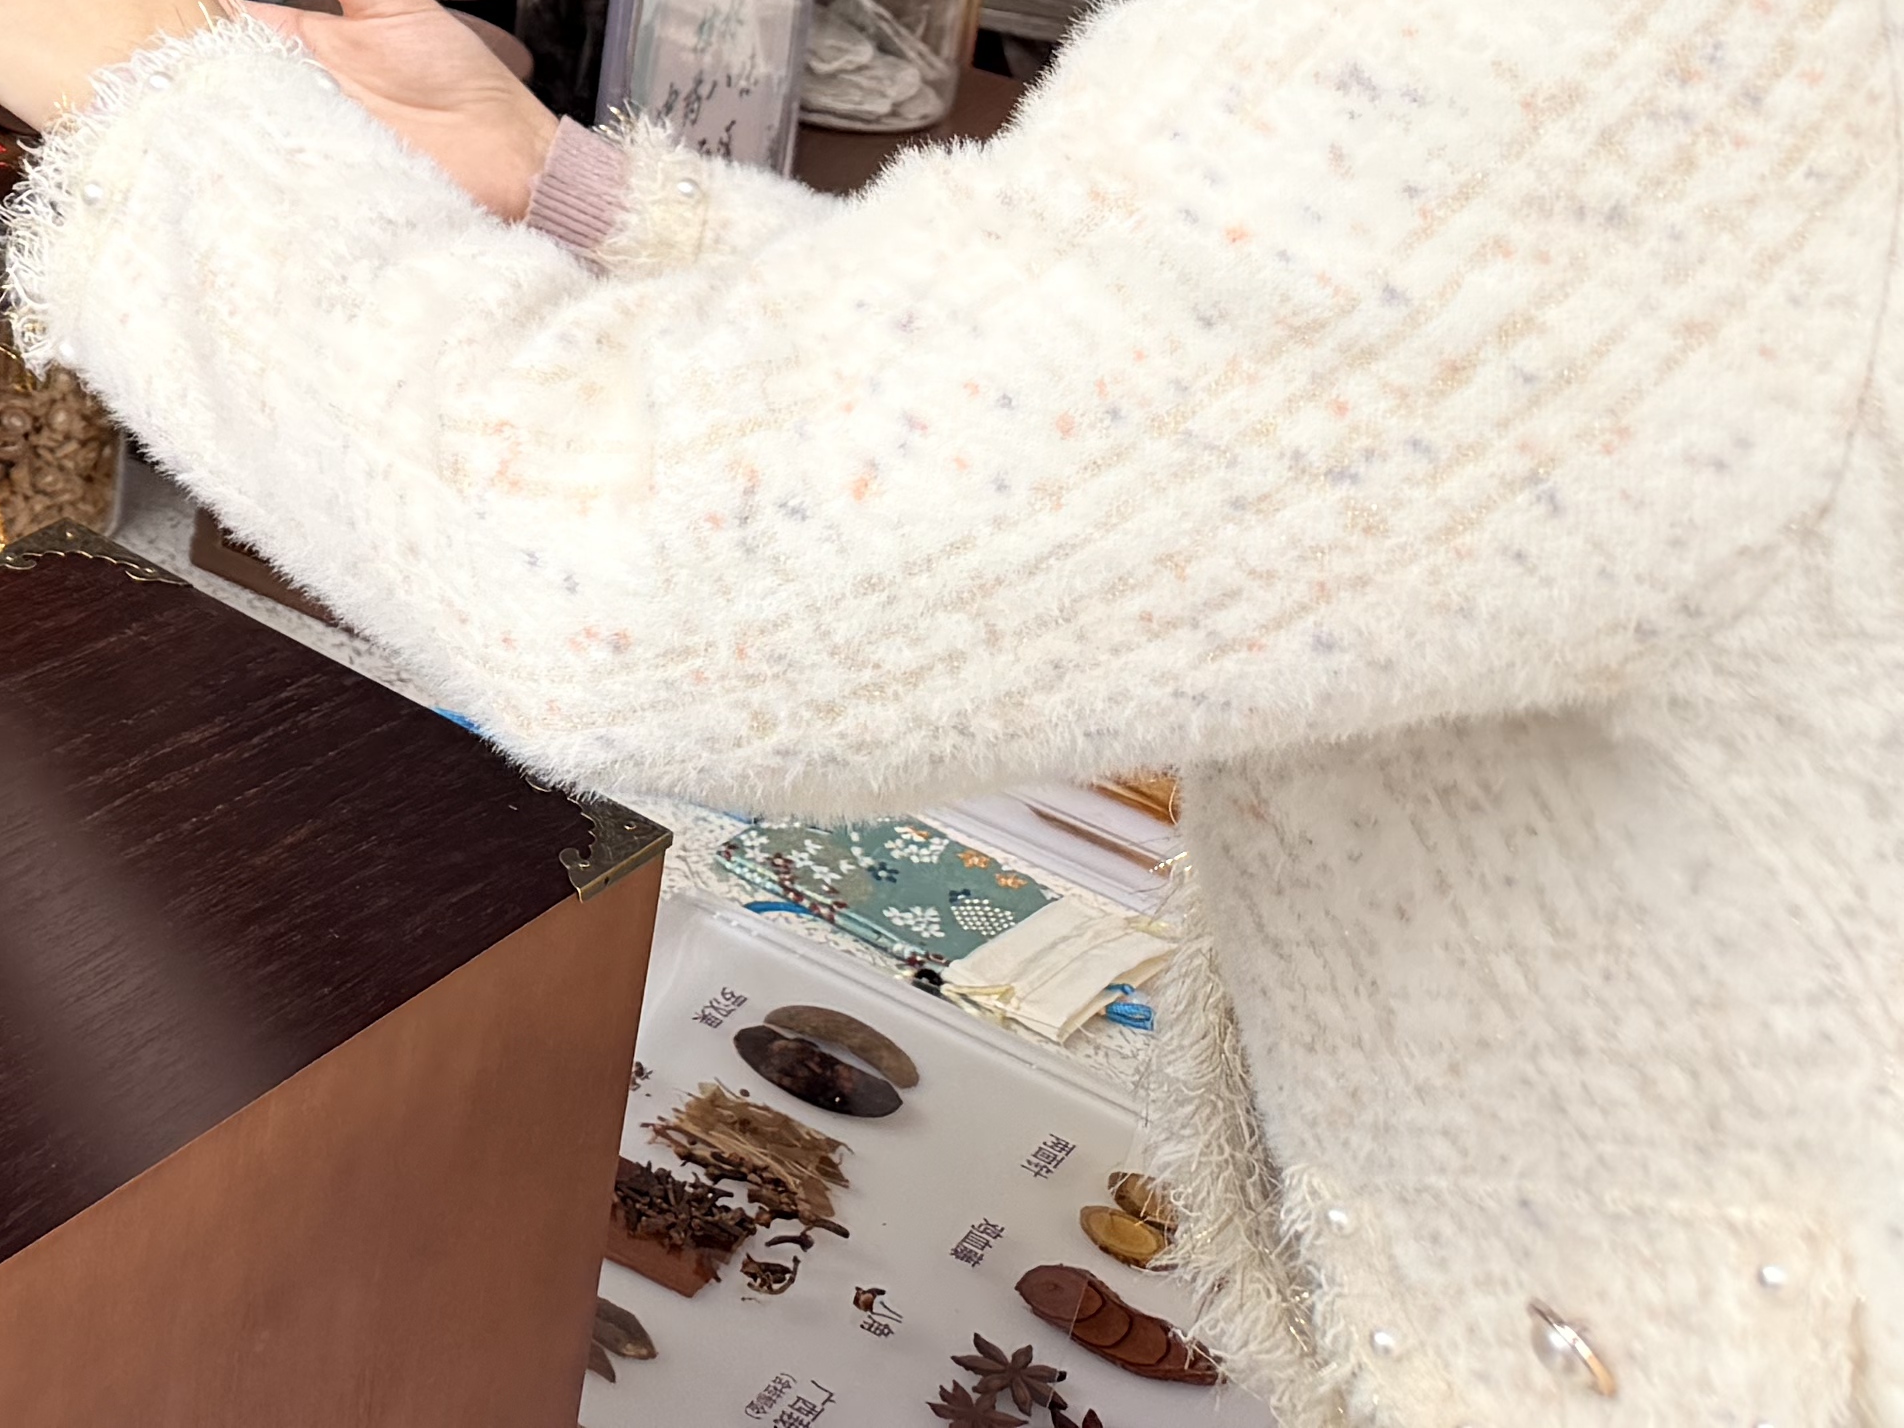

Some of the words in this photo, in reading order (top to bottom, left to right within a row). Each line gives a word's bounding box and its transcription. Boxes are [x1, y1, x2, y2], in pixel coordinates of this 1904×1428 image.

[691, 986, 751, 1029] 罗汉果
[1020, 1133, 1076, 1180] 两面针
[949, 1217, 1007, 1269] 鸡血藤
[860, 1300, 903, 1338] 八角
[772, 1379, 836, 1428] 广西莪
